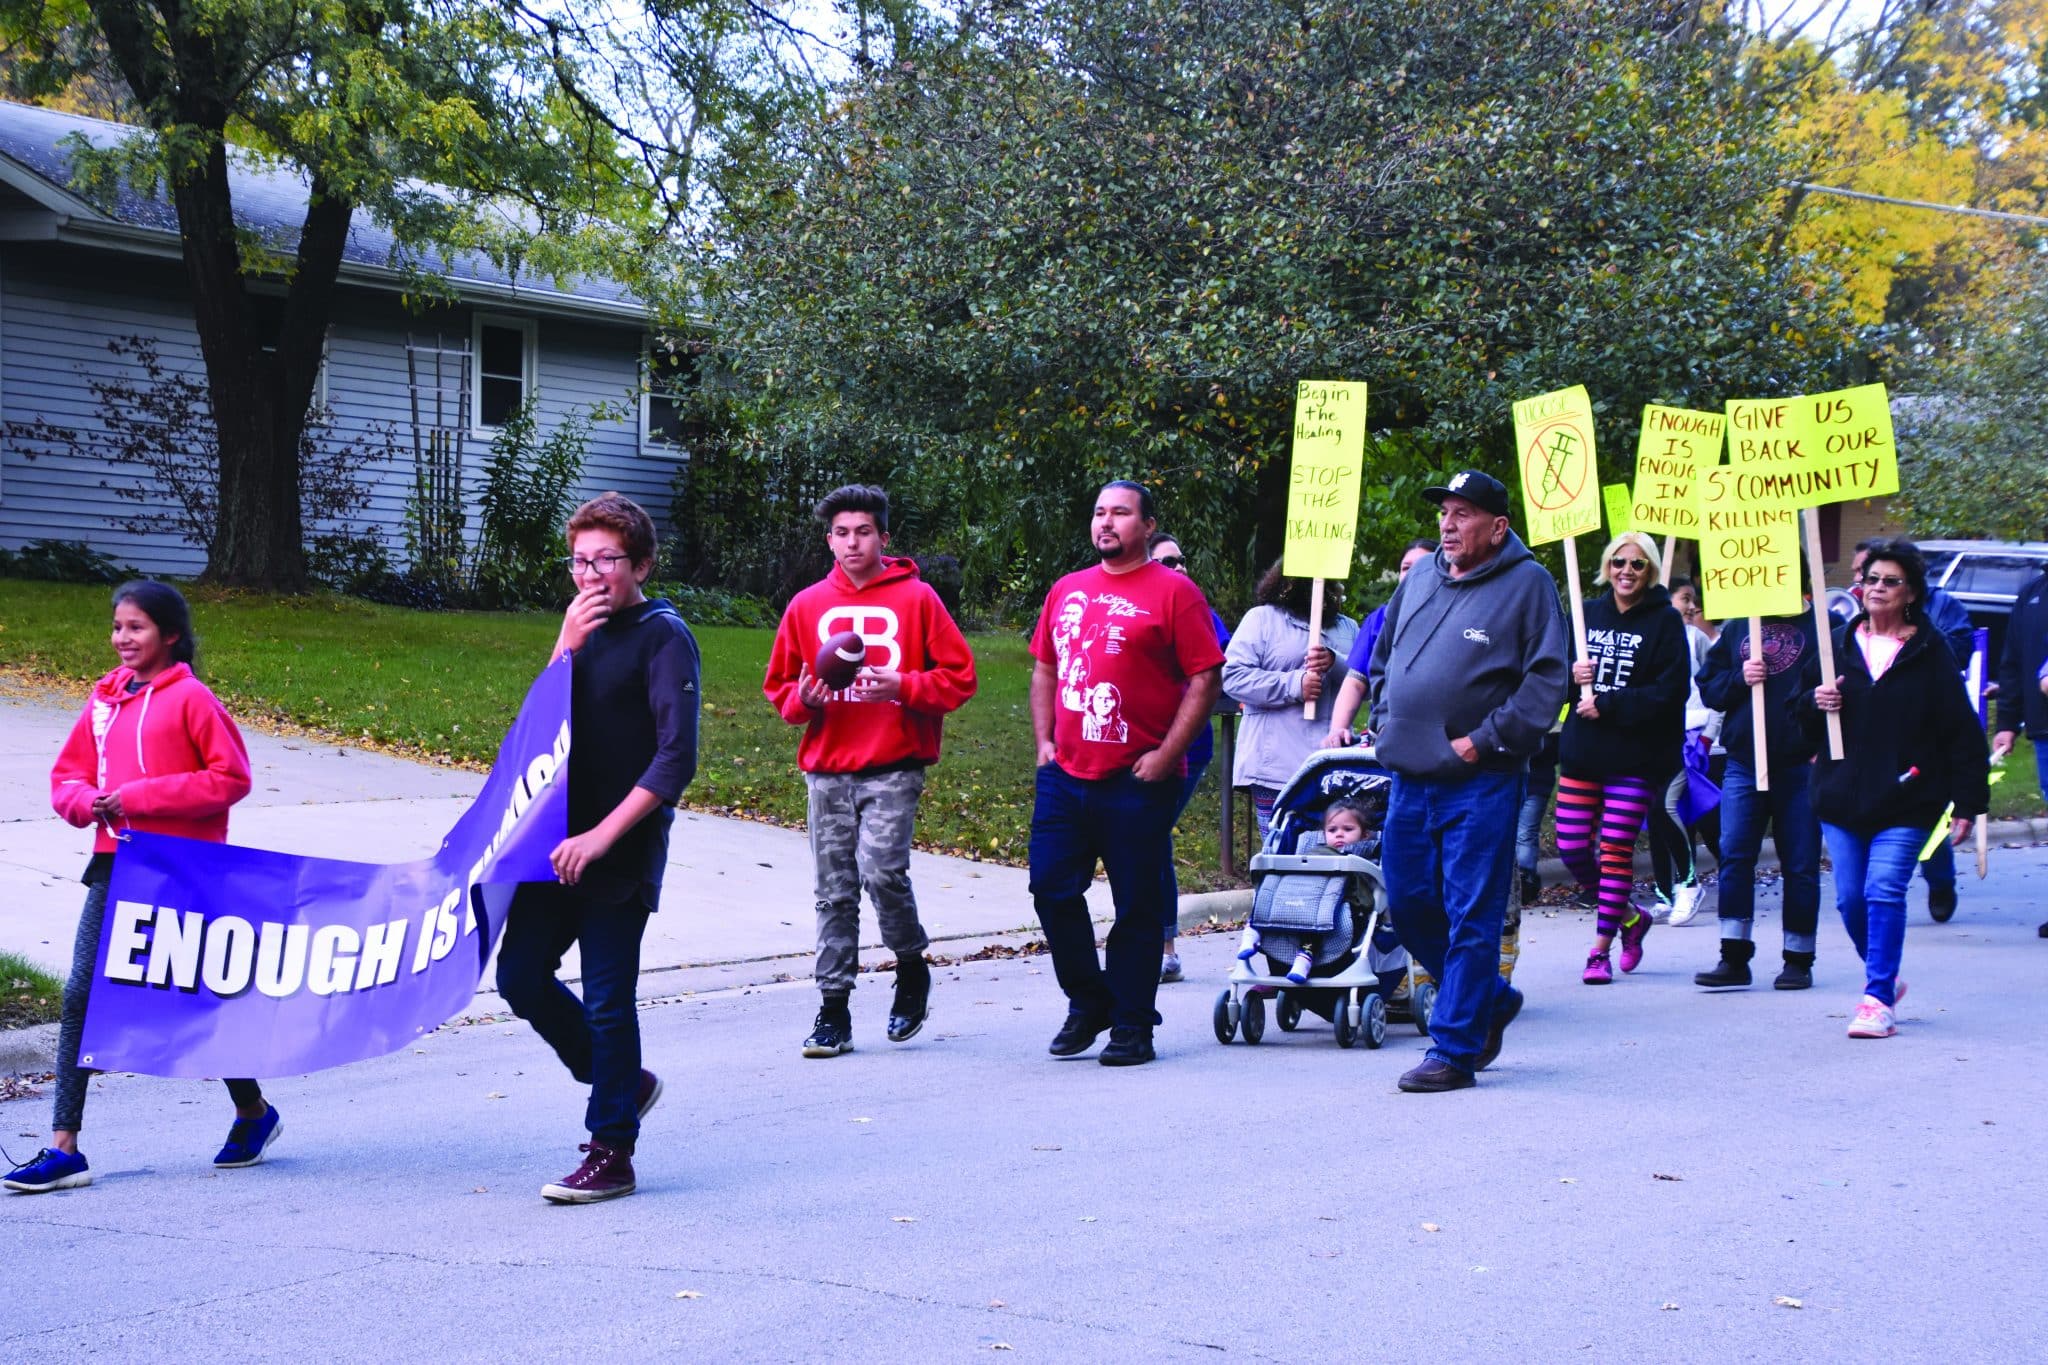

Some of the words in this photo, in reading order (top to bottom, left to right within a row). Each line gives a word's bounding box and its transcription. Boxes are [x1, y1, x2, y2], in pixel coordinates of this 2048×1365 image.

[1299, 383, 1349, 407] Begin
[1305, 406, 1337, 421] the
[1649, 410, 1720, 438] ENOUGH
[1733, 405, 1788, 430] GIVE
[1816, 399, 1853, 424] US
[1297, 423, 1342, 445] Healing
[1740, 439, 1807, 462] BACK
[1826, 427, 1886, 454] OUR
[1663, 438, 1692, 458] IS
[1293, 465, 1352, 486] STOP
[1640, 456, 1696, 478] ENOUG
[1737, 458, 1879, 500] COMMUNITY
[1296, 489, 1341, 508] THE
[1656, 483, 1688, 498] IN
[1288, 519, 1352, 541] DEALING
[1709, 510, 1792, 531] KILLING
[1720, 535, 1780, 559] OUR
[1705, 565, 1789, 591] PEOPLE
[1603, 645, 1615, 657] IS
[104, 900, 408, 998] ENOUGH
[411, 888, 461, 975] IS
